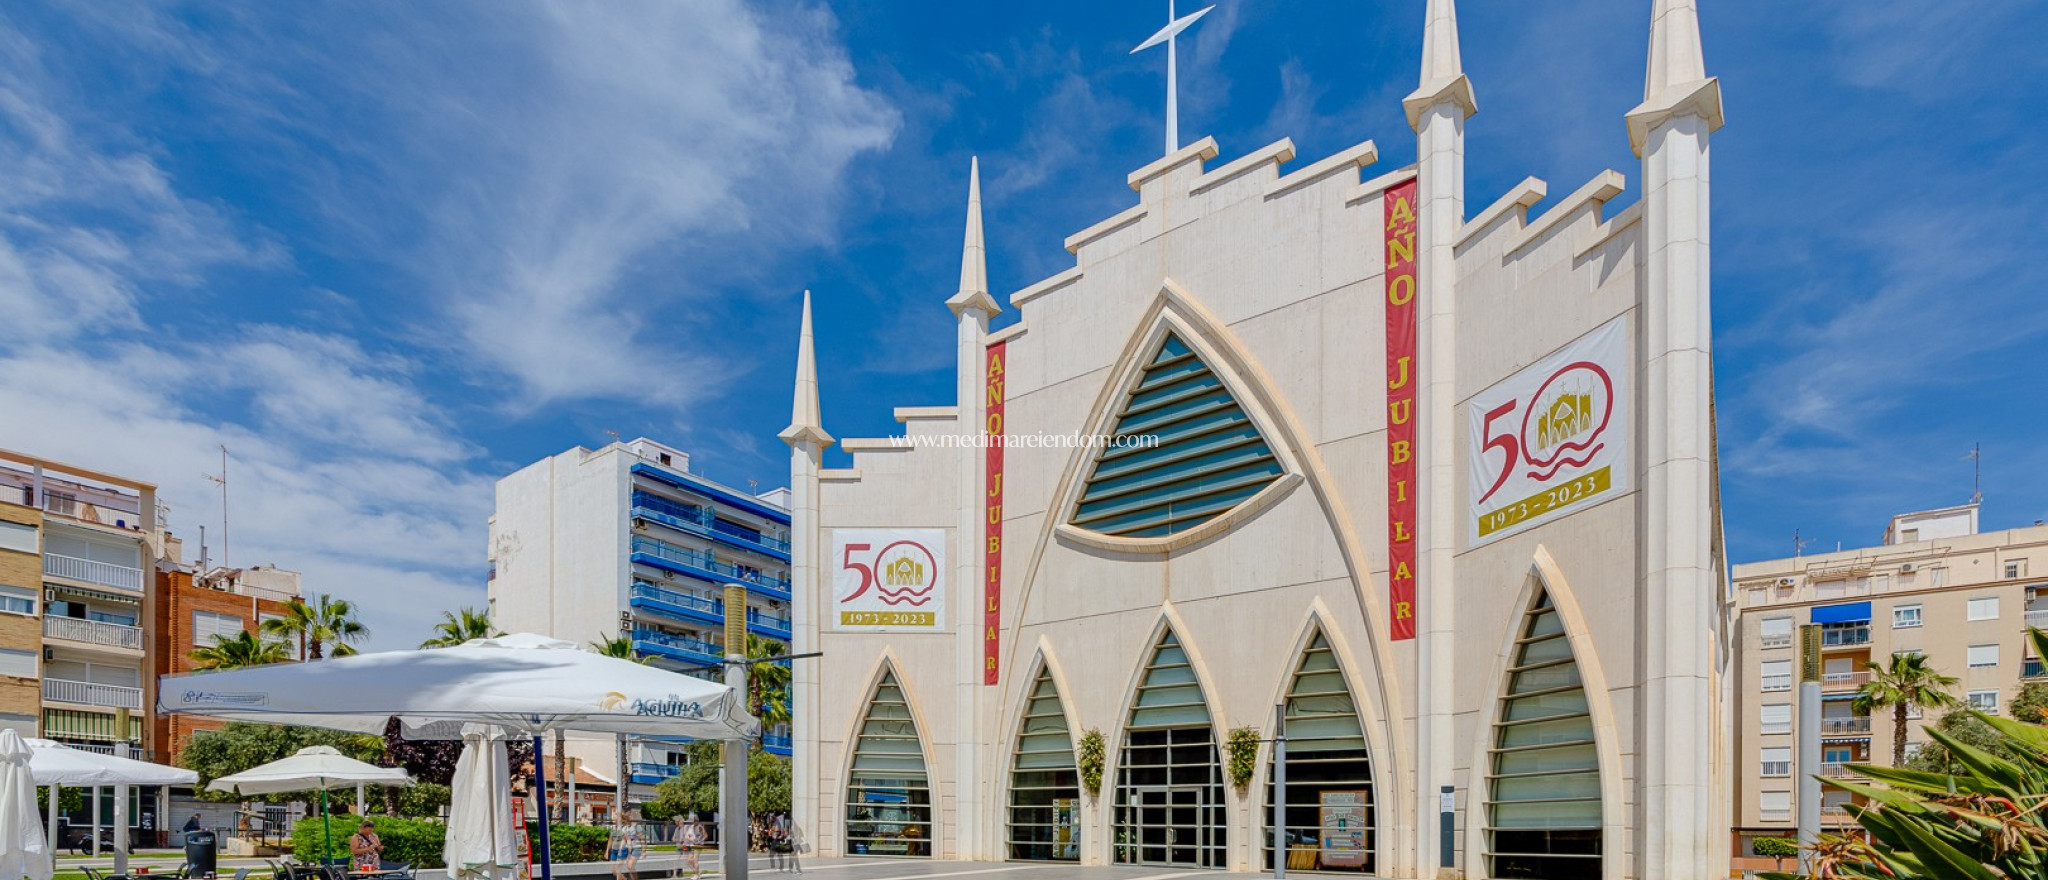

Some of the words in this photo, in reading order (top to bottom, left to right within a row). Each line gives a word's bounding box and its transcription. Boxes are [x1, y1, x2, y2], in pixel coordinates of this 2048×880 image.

[1386, 196, 1416, 306] AÑO
[986, 353, 1004, 436] AÑO
[1478, 361, 1614, 505] 50
[1388, 355, 1413, 621] JUBILAR
[840, 540, 938, 604] 50
[986, 472, 1002, 671] JUBILAR
